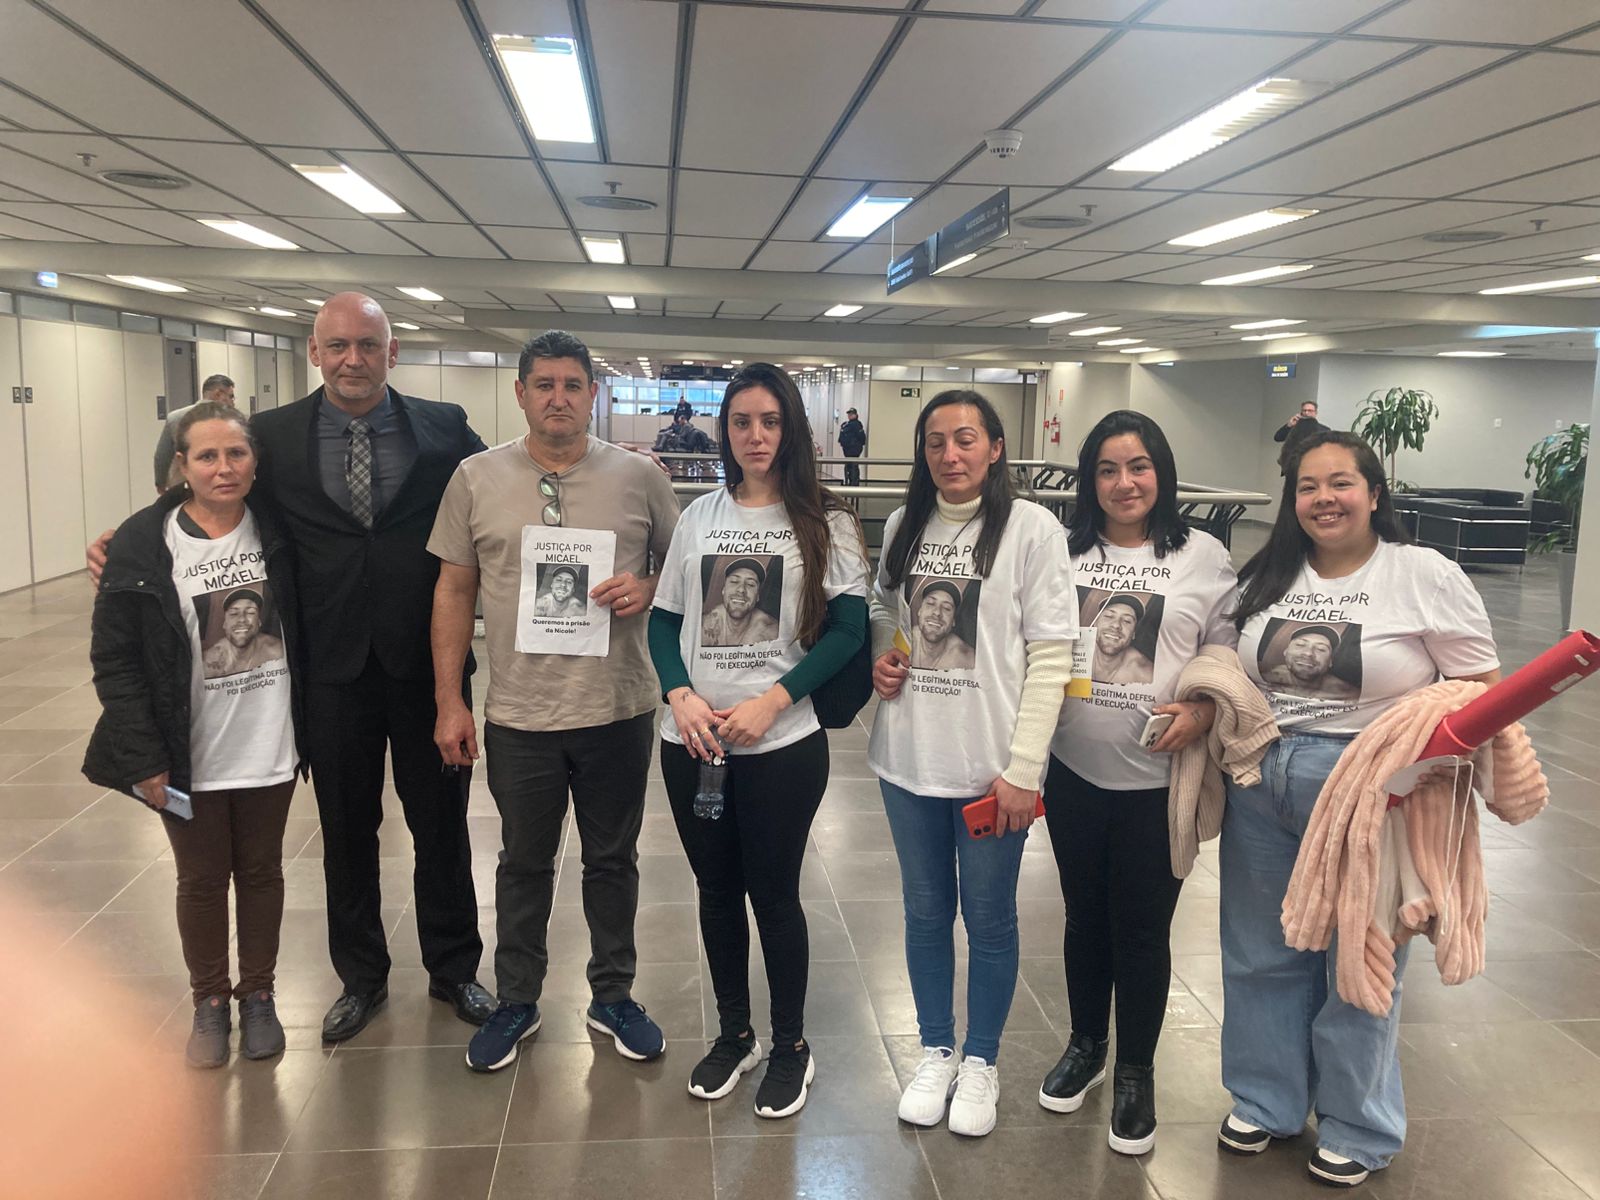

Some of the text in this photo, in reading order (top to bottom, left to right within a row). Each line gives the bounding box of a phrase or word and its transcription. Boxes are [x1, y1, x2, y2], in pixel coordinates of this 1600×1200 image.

[705, 530, 793, 542] JUSTIÇA POR
[534, 542, 592, 553] JUSTIÇA POR
[717, 542, 775, 553] MICAEL.
[920, 543, 958, 560] STIÇA
[182, 555, 238, 579] JUSTIÇA
[915, 559, 974, 577] MICAEL.
[1076, 562, 1171, 579] JUSTIÇA POR
[203, 569, 263, 591] MICAEL.
[1090, 577, 1156, 592] MICAEL.
[1287, 608, 1352, 621] MICAEL.
[532, 618, 564, 626] Queremos
[713, 652, 723, 660] FOI
[724, 650, 756, 660] LEGÍTIMA
[715, 660, 766, 670] FOI EXECUÇÃO!
[204, 682, 220, 691] NÃO
[221, 681, 234, 689] FOI
[917, 674, 951, 686] LEGÍTIMA
[226, 688, 239, 696] FOI
[911, 684, 961, 697] OI EXECUÇÃO!
[1091, 687, 1128, 700] LEGÍTIMA
[1094, 698, 1138, 711] EXECUÇÃO!
